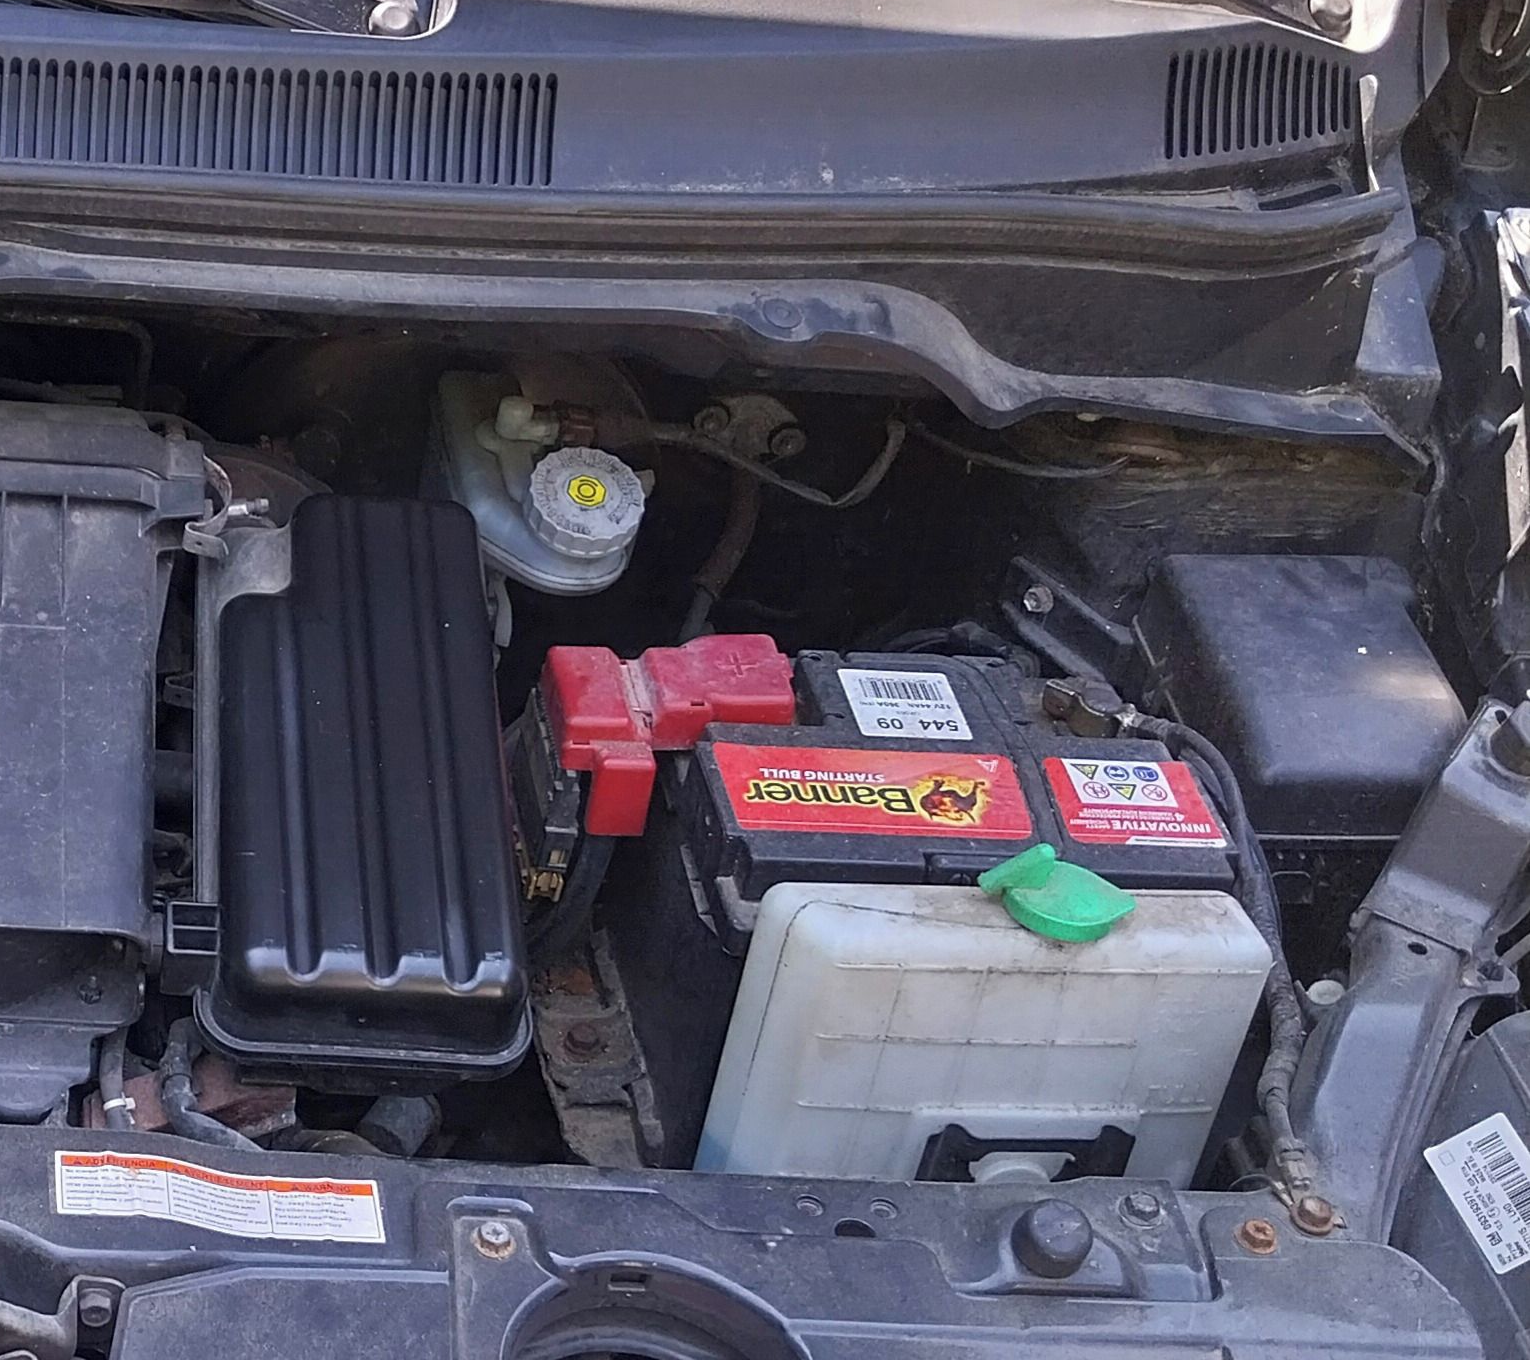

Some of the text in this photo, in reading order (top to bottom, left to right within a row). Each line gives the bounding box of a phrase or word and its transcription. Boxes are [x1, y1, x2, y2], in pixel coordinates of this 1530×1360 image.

[876, 717, 959, 732] 544 09
[759, 767, 886, 784] STARTING BULL
[746, 781, 918, 814] Banner
[1112, 820, 1212, 834] INNOVATIVE
